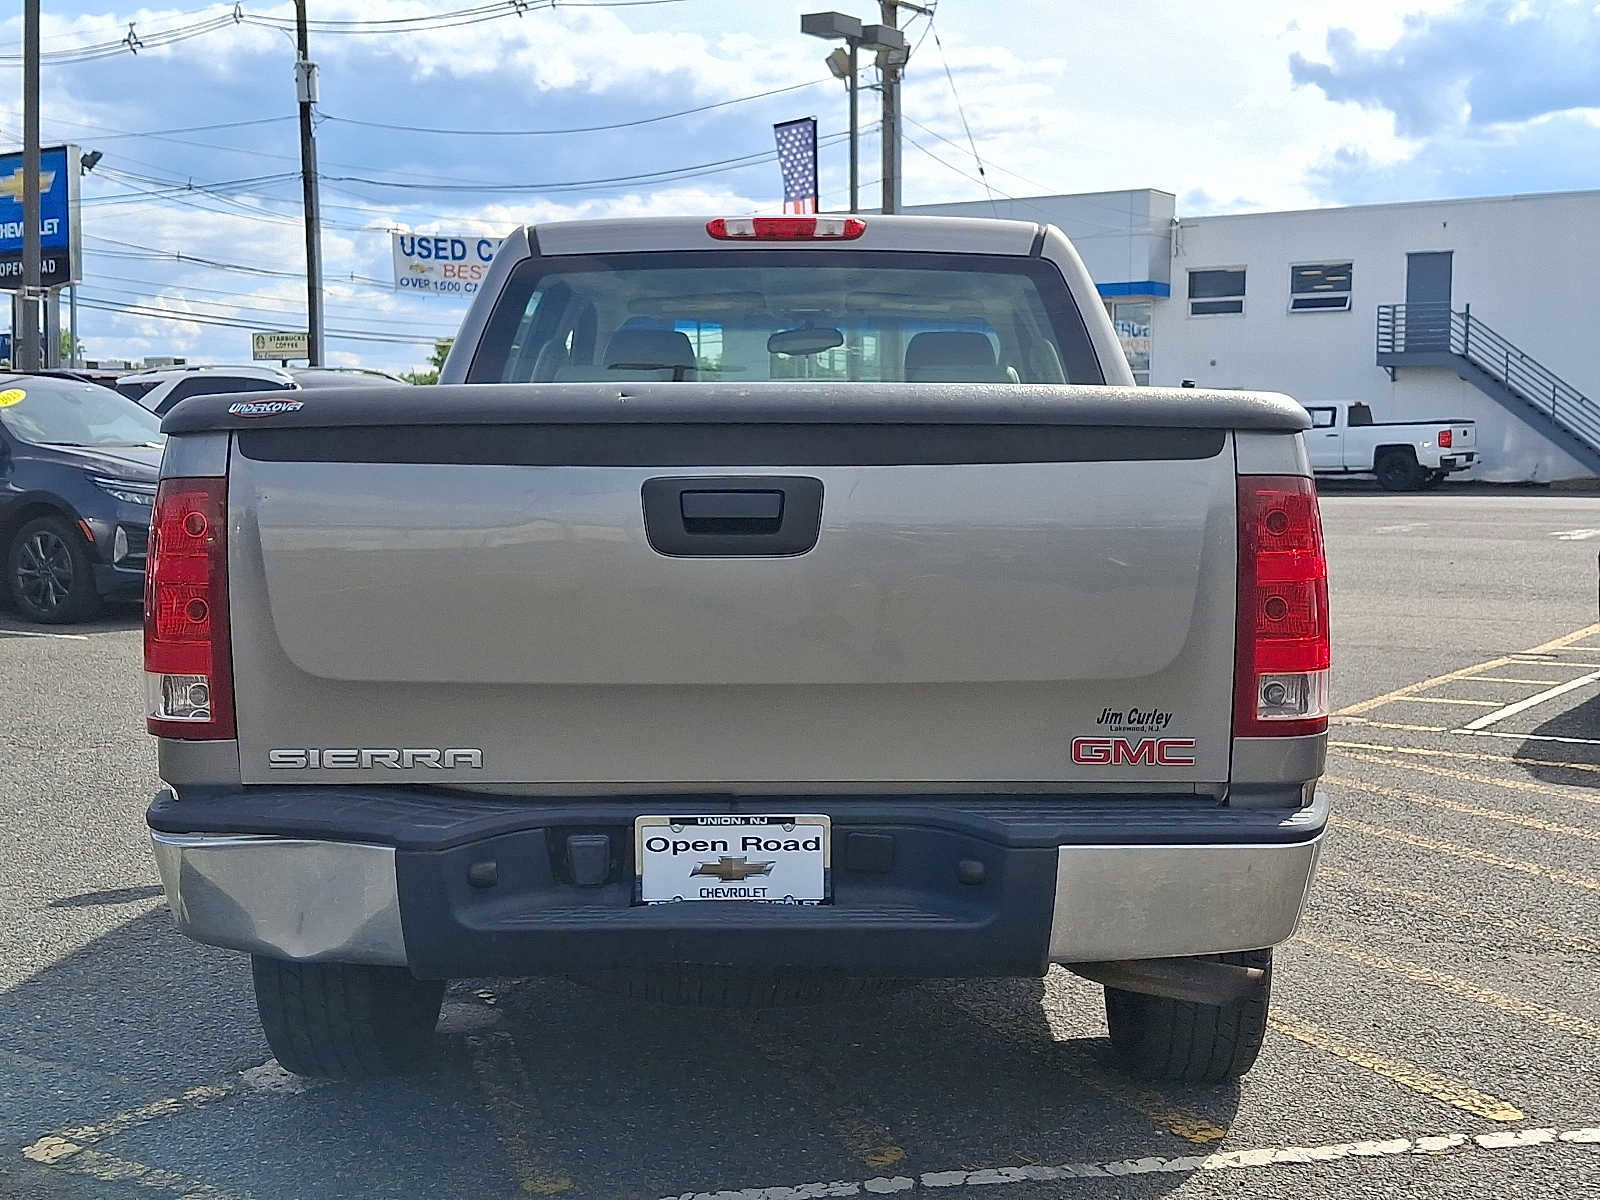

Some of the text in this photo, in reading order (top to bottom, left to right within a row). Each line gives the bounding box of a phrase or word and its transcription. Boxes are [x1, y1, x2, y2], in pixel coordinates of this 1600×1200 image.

[0, 218, 59, 239] HEVLET
[400, 236, 467, 261] USED
[39, 259, 56, 274] AD
[400, 277, 429, 289] OVER
[434, 281, 460, 292] 1500
[1096, 708, 1172, 728] Jim Curley
[1109, 725, 1147, 733] Lakewood,
[269, 748, 484, 769] SIERRA
[1071, 736, 1197, 767] GMC
[697, 816, 768, 825] UNION, NJ
[645, 836, 821, 856] Open Road
[699, 887, 768, 898] CHEVROLET
